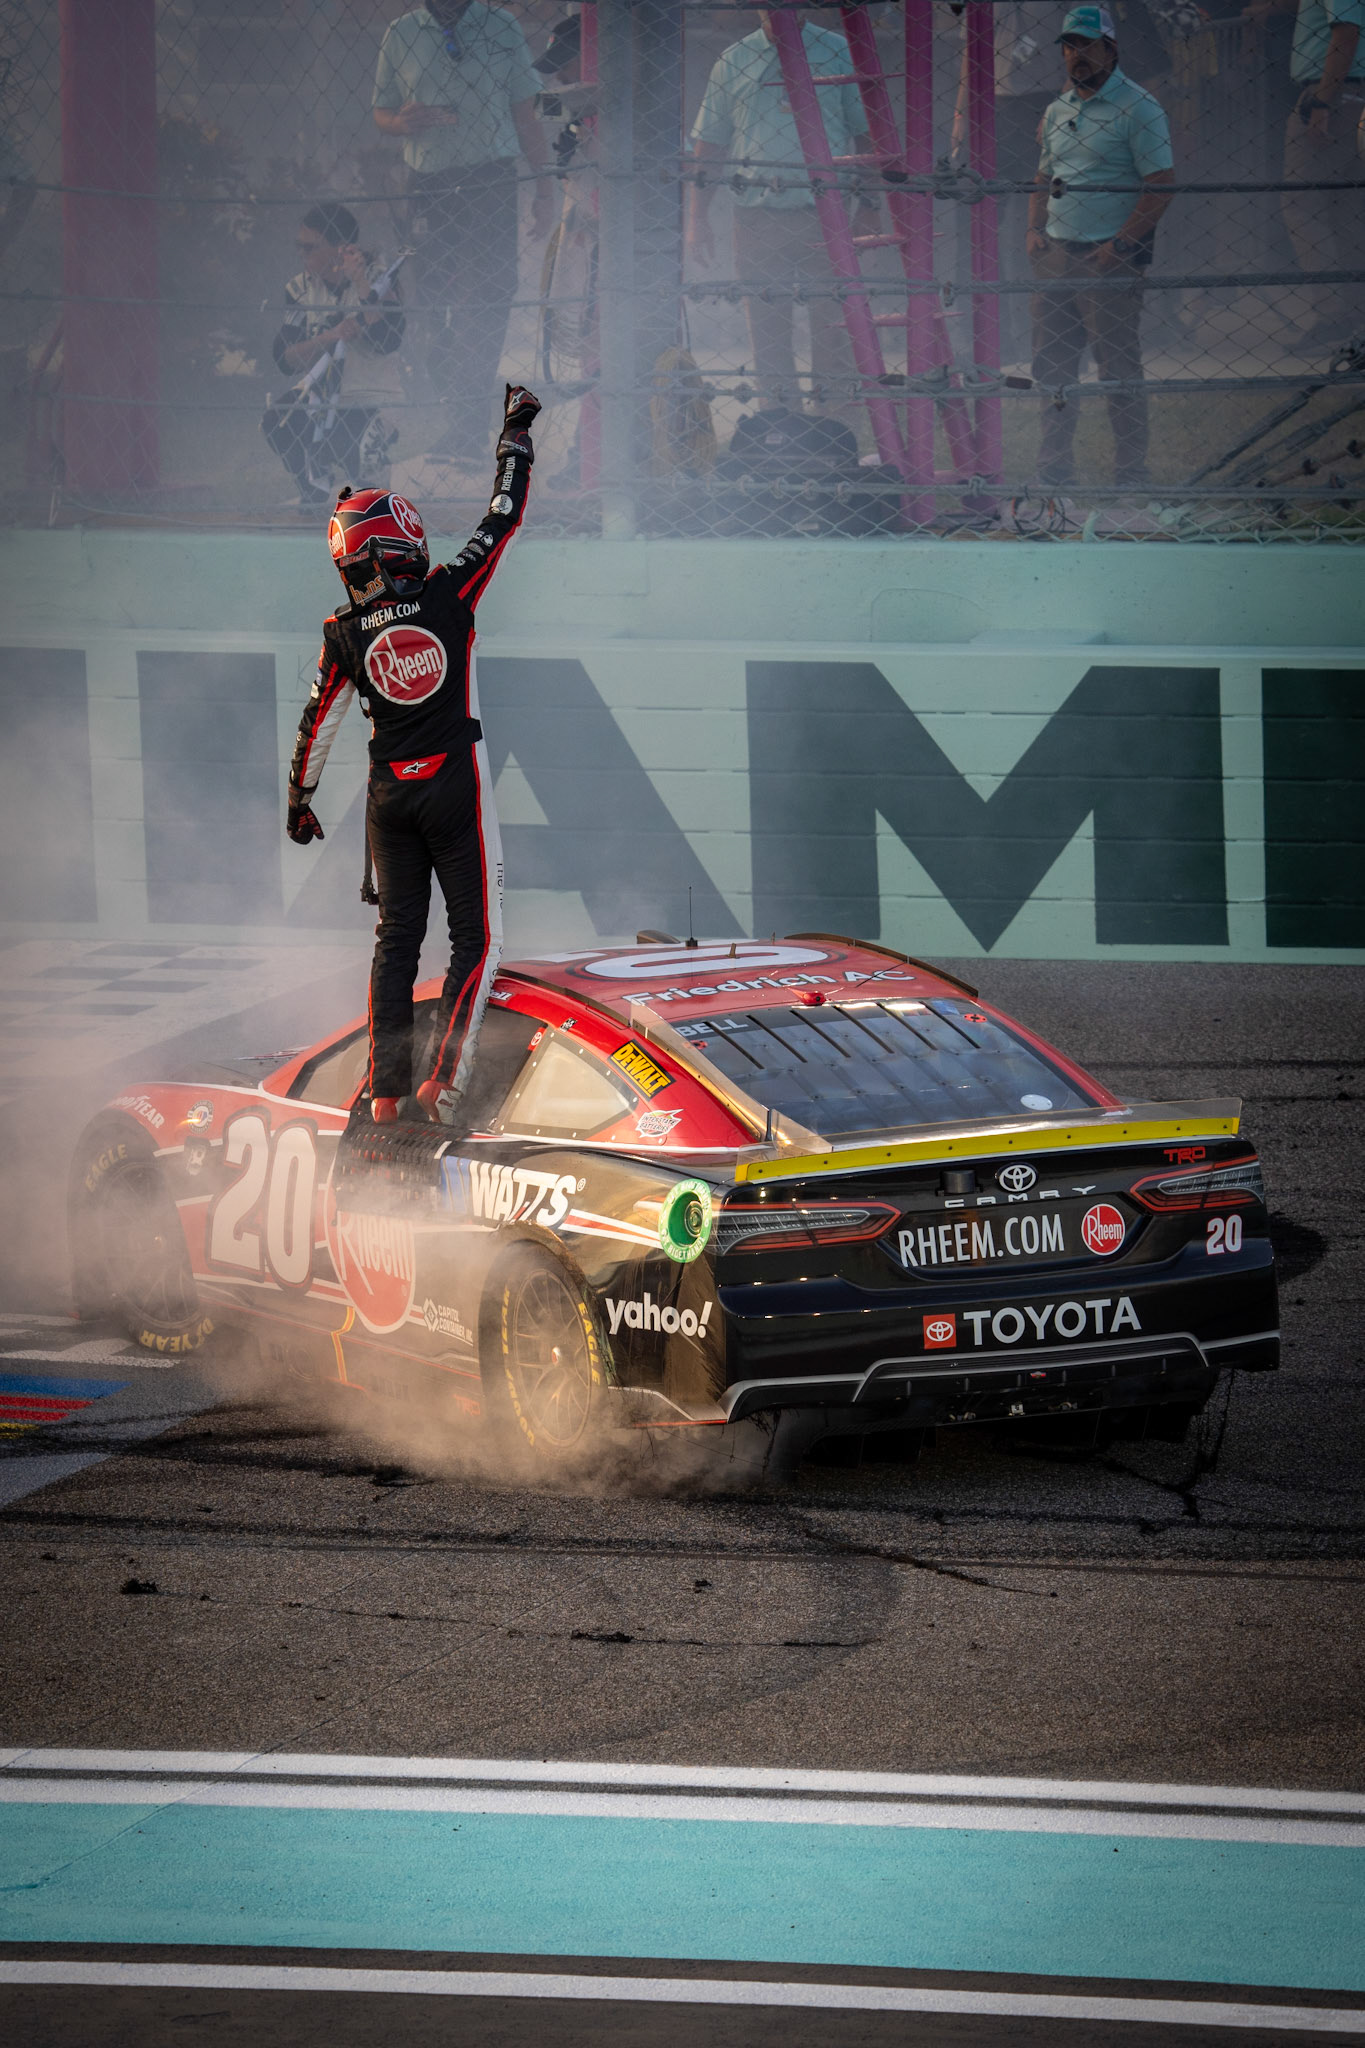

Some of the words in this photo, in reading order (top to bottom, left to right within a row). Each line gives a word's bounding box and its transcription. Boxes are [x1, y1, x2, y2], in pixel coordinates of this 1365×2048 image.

[361, 600, 421, 632] RHEEM.COM
[371, 634, 443, 692] Rheem
[0, 646, 1365, 958] IAMI
[622, 971, 837, 1006] Friedrich
[675, 1018, 749, 1037] BELL
[612, 1043, 669, 1096] DEWALT
[639, 1122, 669, 1132] BATTERIES
[642, 1115, 677, 1126] INTERSTATE
[1164, 1146, 1206, 1165] TRD
[208, 1111, 318, 1287] 20
[944, 1185, 1097, 1209] CAMRY
[898, 1213, 1065, 1268] RHEEM.COM
[1087, 1205, 1123, 1251] Rheem
[1205, 1214, 1243, 1255] 20
[605, 1292, 713, 1339] yahoo!
[963, 1297, 1142, 1347] TOYOTA
[577, 1301, 601, 1387] EAGLE
